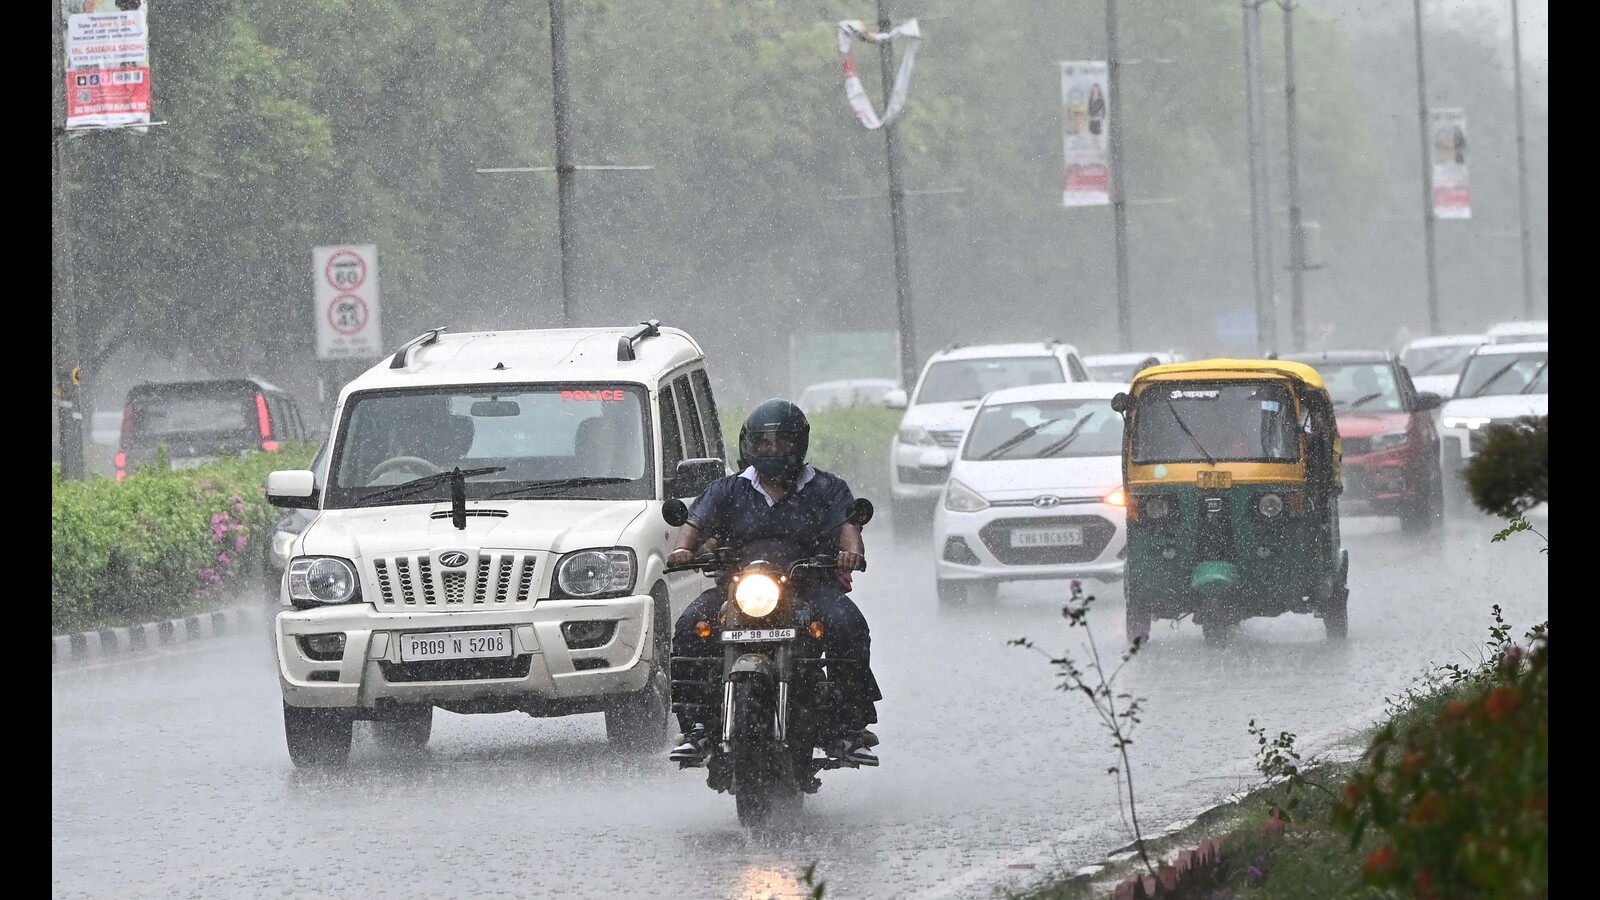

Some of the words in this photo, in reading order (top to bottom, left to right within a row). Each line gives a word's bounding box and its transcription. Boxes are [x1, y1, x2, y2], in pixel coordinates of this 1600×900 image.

[86, 45, 116, 54] SAMAIRA
[336, 271, 358, 285] 60
[561, 390, 625, 401] POLICE
[731, 631, 743, 640] HP
[750, 630, 762, 639] 98
[769, 630, 791, 638] 0846
[412, 639, 445, 655] PB09
[453, 638, 462, 653] N
[469, 636, 504, 653] 5208
